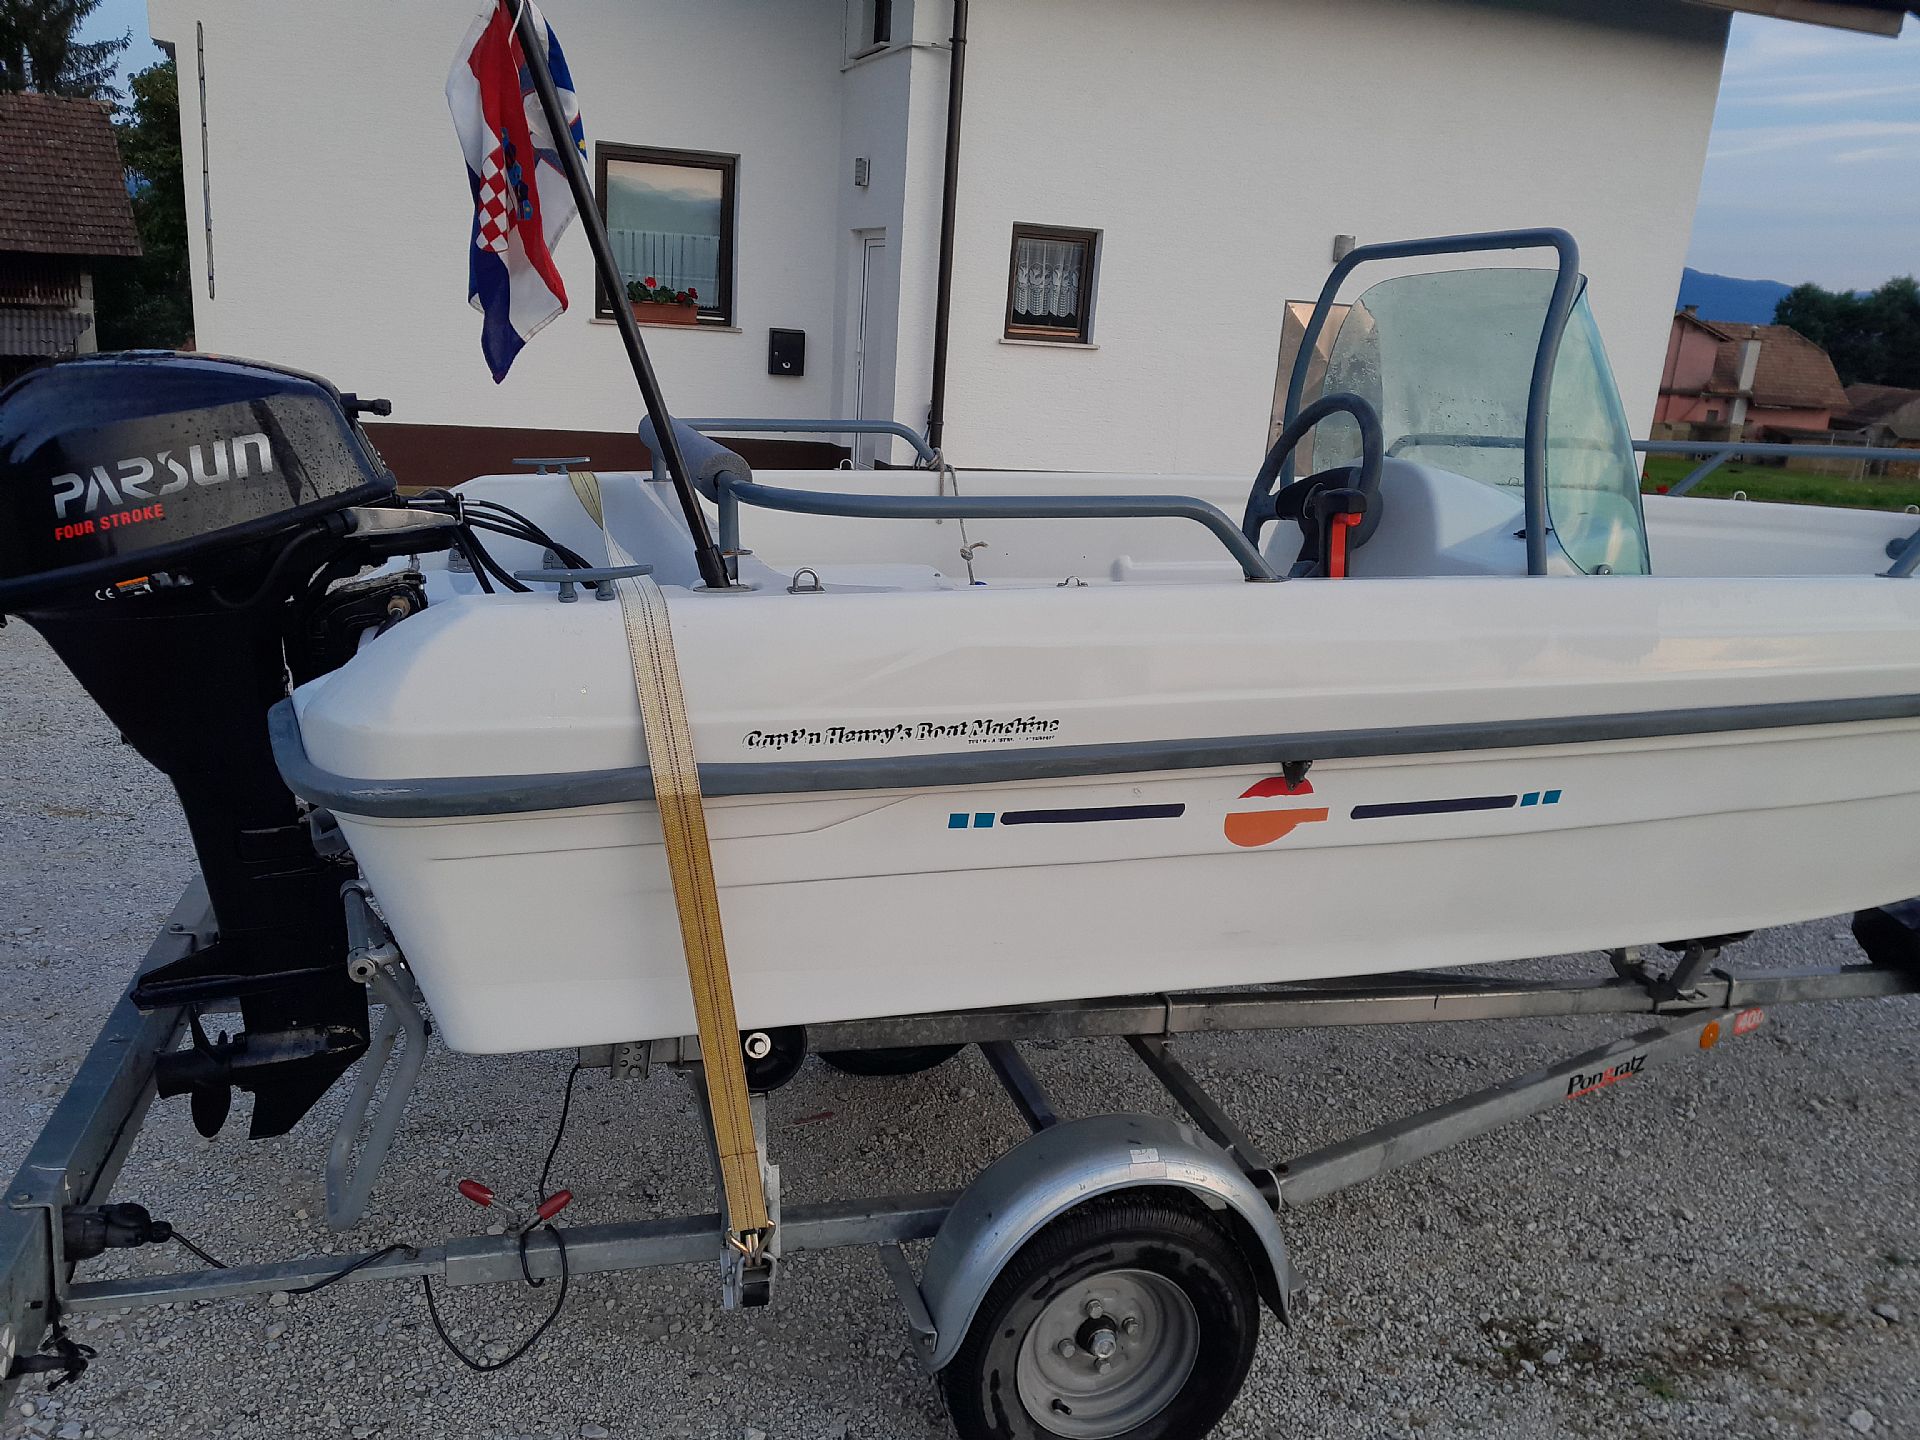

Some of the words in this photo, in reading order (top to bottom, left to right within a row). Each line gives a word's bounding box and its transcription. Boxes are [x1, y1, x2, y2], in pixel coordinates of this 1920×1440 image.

[51, 432, 274, 519] PARSUN
[55, 522, 94, 541] FOUR
[100, 504, 164, 531] STROKE
[743, 729, 821, 750] Capt'n
[824, 724, 912, 746] Henry's
[916, 720, 967, 741] Boat
[969, 716, 1060, 738] Machine
[1567, 1054, 1648, 1095] Pongratz
